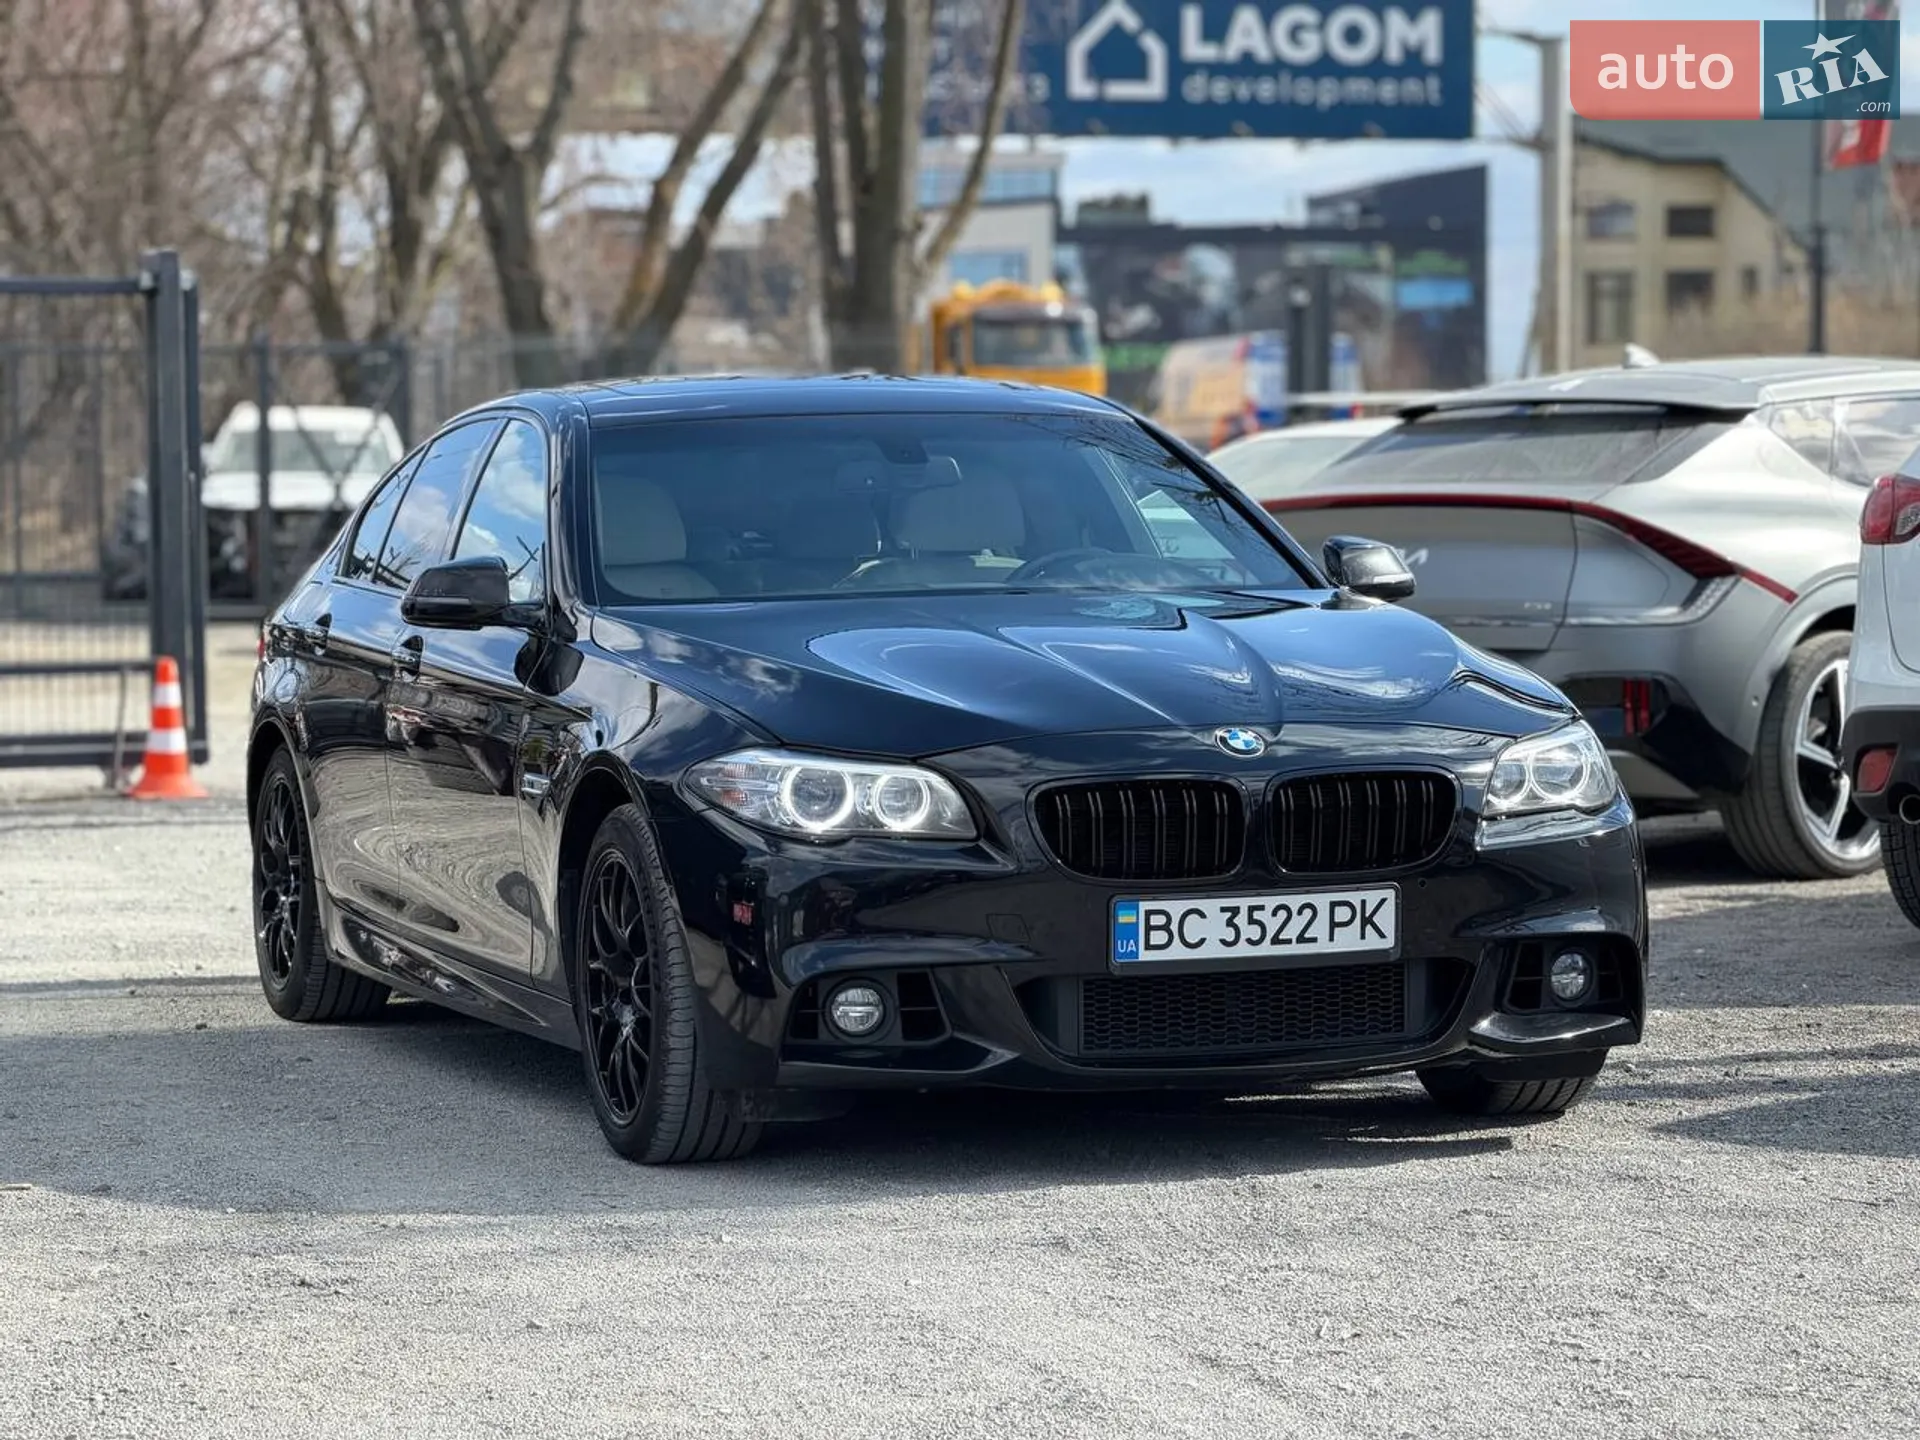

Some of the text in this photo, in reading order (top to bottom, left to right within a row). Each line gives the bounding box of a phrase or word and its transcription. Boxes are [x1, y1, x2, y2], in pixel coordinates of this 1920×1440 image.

[1181, 4, 1443, 66] LAGOM
[1181, 69, 1442, 111] development
[1117, 940, 1137, 953] UA
[1144, 898, 1388, 951] BC 3522 PK
